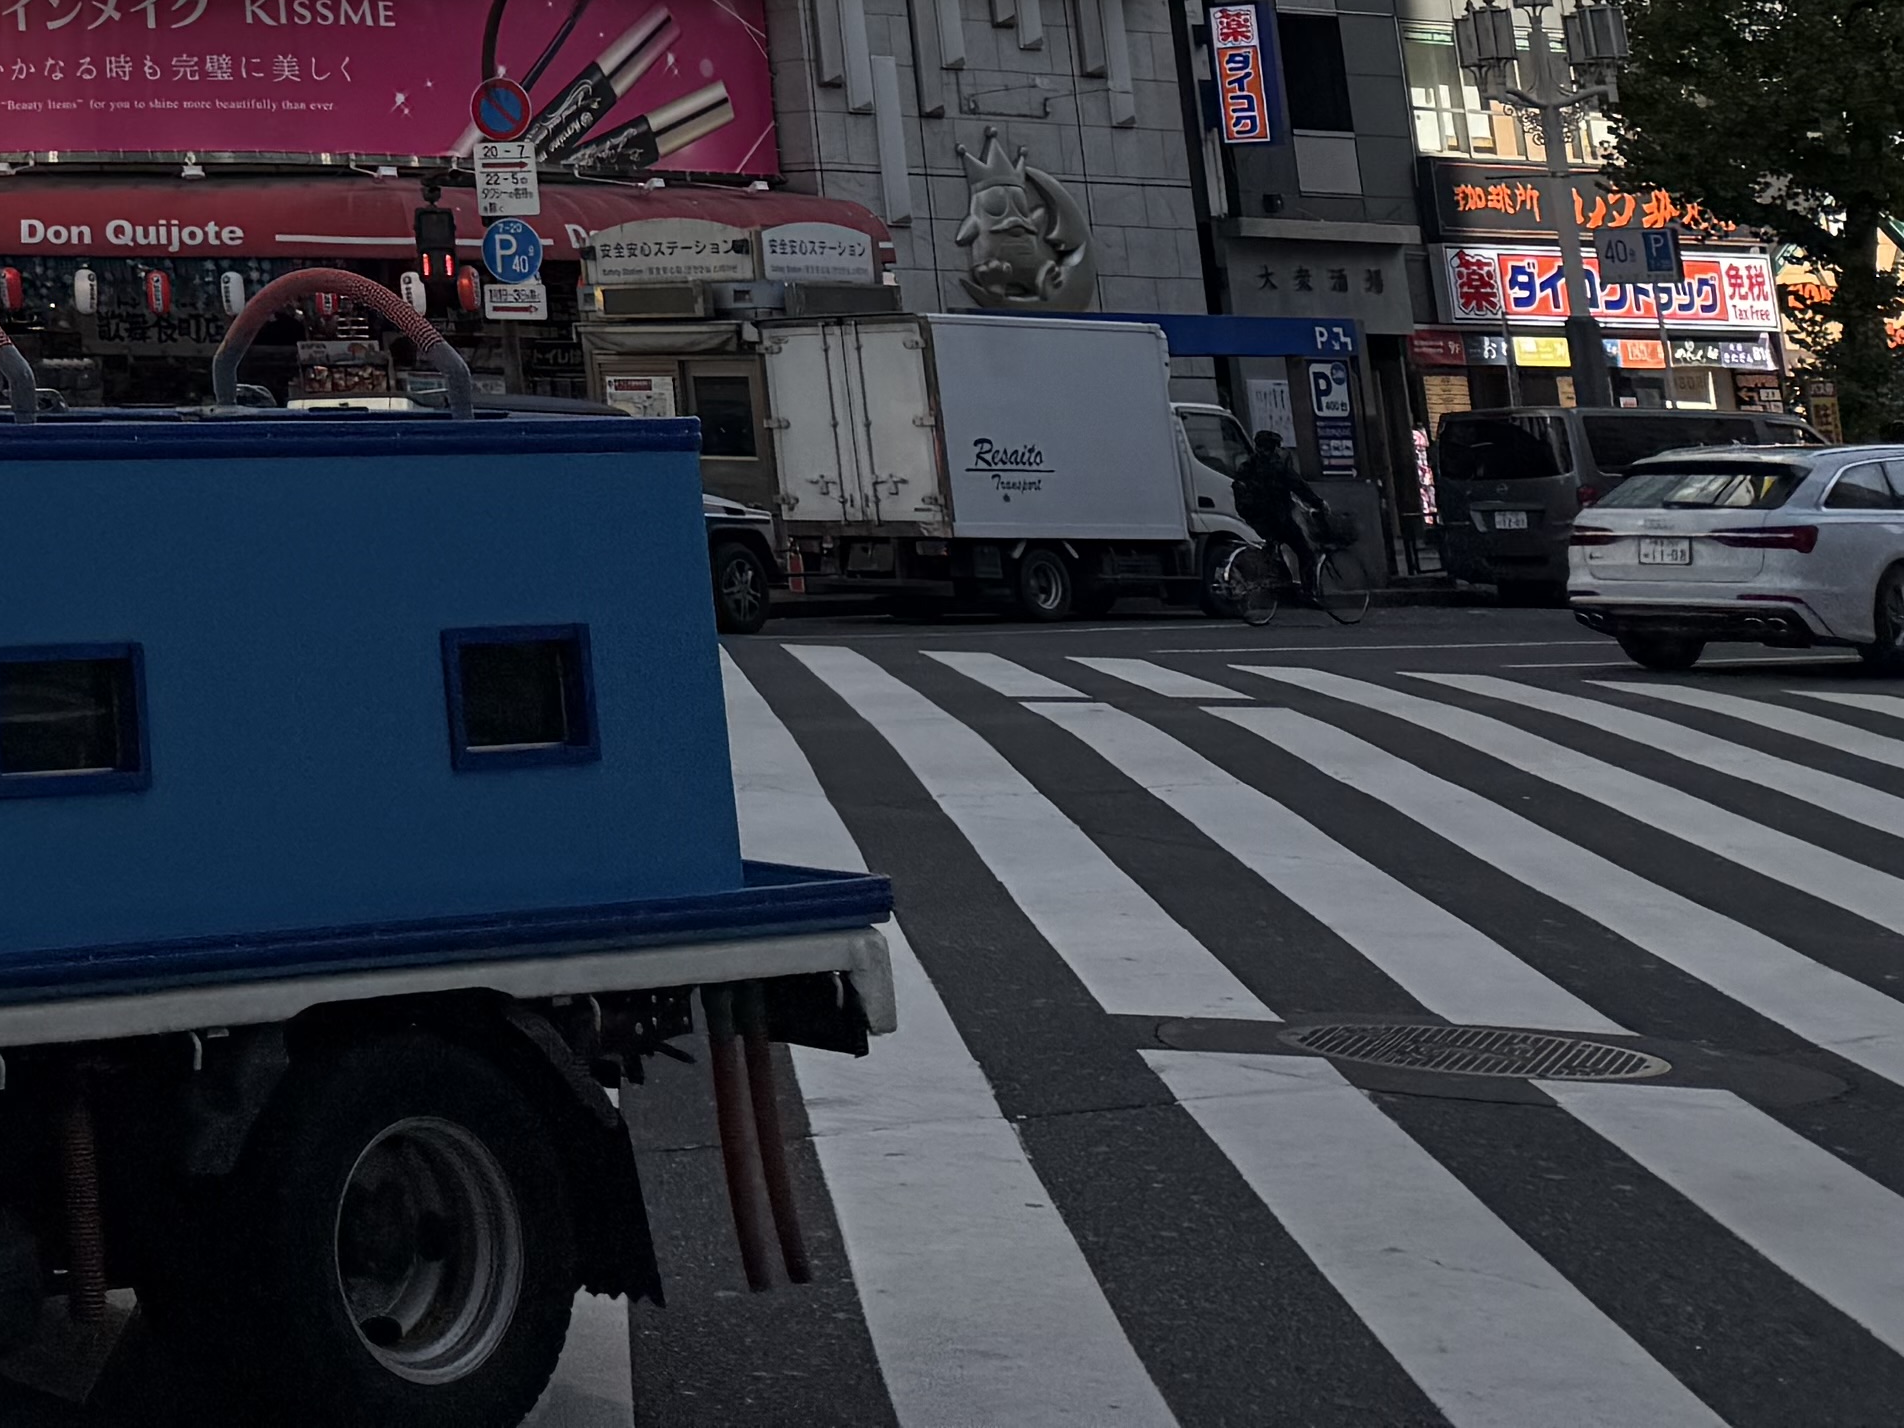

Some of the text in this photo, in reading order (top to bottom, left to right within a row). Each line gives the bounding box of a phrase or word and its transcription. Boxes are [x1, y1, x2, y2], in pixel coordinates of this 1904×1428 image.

[109, 101, 131, 113] you
[149, 98, 179, 111] shine
[182, 100, 212, 111] more
[215, 98, 278, 113] beautifully
[1225, 51, 1259, 136] ダイコク
[19, 218, 246, 253] Don Quijote
[1650, 234, 1664, 257] P
[493, 233, 518, 274] P
[599, 238, 735, 260] 安全安心ステーション
[767, 239, 868, 259] 安全安心ステーション
[1604, 239, 1628, 264] 40
[1453, 251, 1770, 314] 薬 免税
[1314, 326, 1328, 350] P
[1312, 371, 1332, 413] P
[972, 438, 1045, 469] Resaito
[991, 474, 1044, 494] Transport
